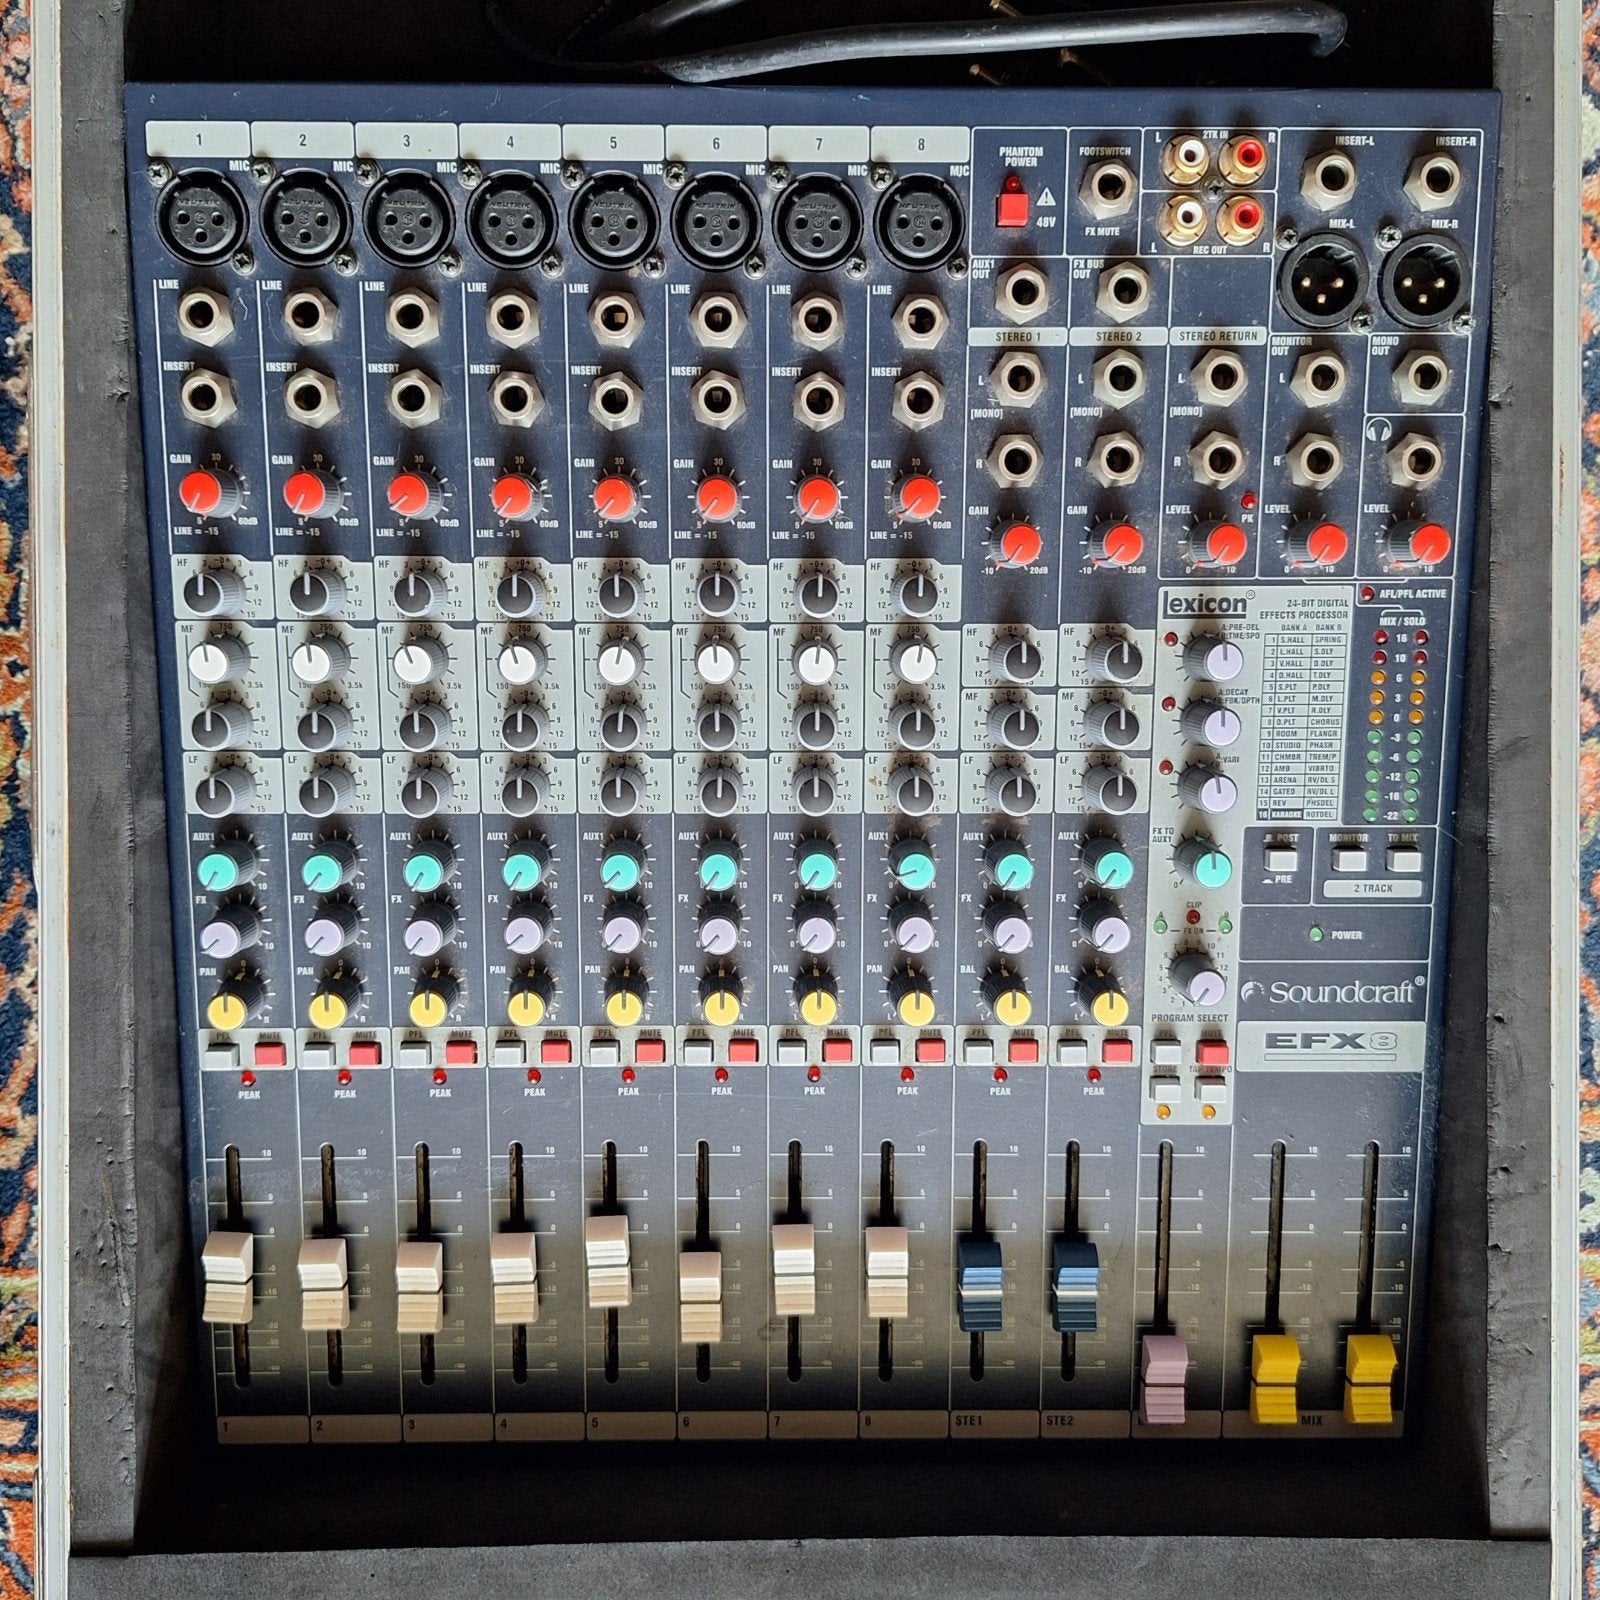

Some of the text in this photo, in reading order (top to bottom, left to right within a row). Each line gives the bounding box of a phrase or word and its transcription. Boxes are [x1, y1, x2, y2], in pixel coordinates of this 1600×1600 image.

[1203, 130, 1229, 140] 2TK IN
[197, 134, 203, 147] 1
[300, 134, 308, 147] 2
[403, 135, 411, 148] 3
[506, 136, 515, 149] 4
[610, 137, 618, 150] 5
[713, 137, 721, 150] 6
[816, 138, 823, 151] 7
[918, 138, 926, 152] 8
[1335, 136, 1375, 147] INSERT-L
[1436, 137, 1477, 147] INSERT-R
[999, 147, 1044, 157] PHANTOM
[1079, 147, 1132, 157] FOOTSWITCH
[229, 160, 251, 172] MIC
[333, 161, 355, 173] MIC
[1005, 157, 1038, 167] POWER
[437, 161, 458, 174] MIC
[540, 163, 561, 175] MIC
[643, 164, 664, 176] MIC
[745, 165, 766, 176] MIC
[848, 165, 868, 177] MIC
[1036, 217, 1057, 228] 48V
[1329, 219, 1355, 229] MIX-L
[1431, 219, 1459, 229] MIX-R
[1085, 228, 1120, 237] FX MUTE
[1193, 246, 1228, 255] REC OUT
[973, 259, 995, 269] AUX1
[1074, 259, 1105, 269] FX BUS
[972, 270, 991, 280] OUT
[1074, 270, 1092, 280] OUT
[158, 279, 179, 290] LINE
[262, 280, 283, 291] LINE
[364, 281, 385, 292] LINE
[467, 282, 487, 293] LINE
[569, 284, 589, 294] LINE
[772, 285, 791, 295] LINE
[873, 285, 892, 296] LINE
[996, 332, 1041, 342] STEREO 1
[1096, 332, 1142, 342] STEREO 2
[1179, 332, 1258, 342] STEREO RETURN
[1272, 337, 1313, 346] MONITOR
[1372, 336, 1399, 346] MONO
[1271, 347, 1289, 356] OUT
[1372, 347, 1390, 356] OUT
[163, 361, 195, 371] INSERT
[266, 362, 298, 373] INSERT
[368, 363, 400, 374] INSERT
[470, 364, 501, 375] INSERT
[571, 366, 602, 376] INSERT
[671, 366, 702, 377] INSERT
[772, 367, 802, 378] INSERT
[871, 367, 902, 378] INSERT
[971, 409, 1004, 420] [MONO]
[1070, 407, 1103, 418] [MONO]
[1170, 407, 1203, 418] [MONO]
[170, 454, 192, 465] GAIN
[272, 455, 293, 465] GAIN
[474, 457, 495, 468] GAIN
[574, 459, 595, 469] GAIN
[673, 459, 694, 469] GAIN
[871, 459, 892, 470] GAIN
[969, 506, 990, 516] GAIN
[1067, 506, 1088, 515] GAIN
[1166, 505, 1192, 515] LEVEL
[1265, 504, 1291, 514] LEVEL
[1364, 504, 1390, 513] LEVEL
[639, 521, 658, 530] 60dB
[177, 559, 189, 567] HF
[1030, 566, 1049, 575] 20dB
[1128, 566, 1147, 574] 20dB
[1380, 589, 1447, 599] AFL/PFL ACTIVE
[1287, 599, 1349, 608] 24-BIT DIGITAL
[1260, 611, 1349, 620] EFFECTS PROCESSOR
[1380, 618, 1426, 626] MIX SOLO
[181, 625, 195, 634] MF
[966, 628, 978, 636] HF
[1281, 636, 1305, 644] S.HALL
[1315, 636, 1342, 644] SPRING
[1396, 634, 1408, 643] 16
[1395, 654, 1407, 663] 10
[1310, 718, 1340, 726] CHORUS
[188, 756, 198, 764] LF
[1385, 773, 1401, 782] -12
[1383, 812, 1398, 821] -22
[487, 833, 508, 841] AUX1
[868, 832, 889, 841] AUX1
[963, 832, 984, 841] AUX1
[1277, 834, 1300, 842] POST
[1329, 834, 1369, 843] MONITOR
[1388, 834, 1418, 843] TO MIX
[1275, 875, 1292, 884] PRE
[1354, 884, 1393, 893] 2 TRACK
[1332, 931, 1363, 940] POWER
[200, 968, 217, 976] PAN
[490, 966, 506, 974] PAN
[772, 965, 789, 974] PAN
[960, 965, 976, 974] BAL
[1270, 980, 1415, 1004] Soundcraft
[1151, 1014, 1229, 1023] PROGRAM SELECT
[356, 1031, 378, 1039] MUTE
[640, 1029, 662, 1037] MUTE
[1265, 1032, 1399, 1051] EFX8
[239, 1091, 261, 1099] PEAK
[430, 1089, 452, 1098] PEAK
[524, 1088, 546, 1097] PEAK
[712, 1087, 733, 1096] PEAK
[804, 1087, 825, 1095] PEAK
[897, 1087, 919, 1095] PEAK
[1083, 1087, 1105, 1096] PEAK
[316, 1420, 324, 1431] 2
[408, 1419, 416, 1430] 3
[500, 1419, 507, 1429] 4
[592, 1418, 599, 1428] 5
[683, 1417, 690, 1427] 6
[774, 1417, 781, 1427] 7
[865, 1416, 871, 1426] 8
[955, 1415, 983, 1426] STE1
[1046, 1415, 1074, 1426] STE2
[1301, 1415, 1323, 1426] MIX
[223, 1422, 229, 1432] 1
